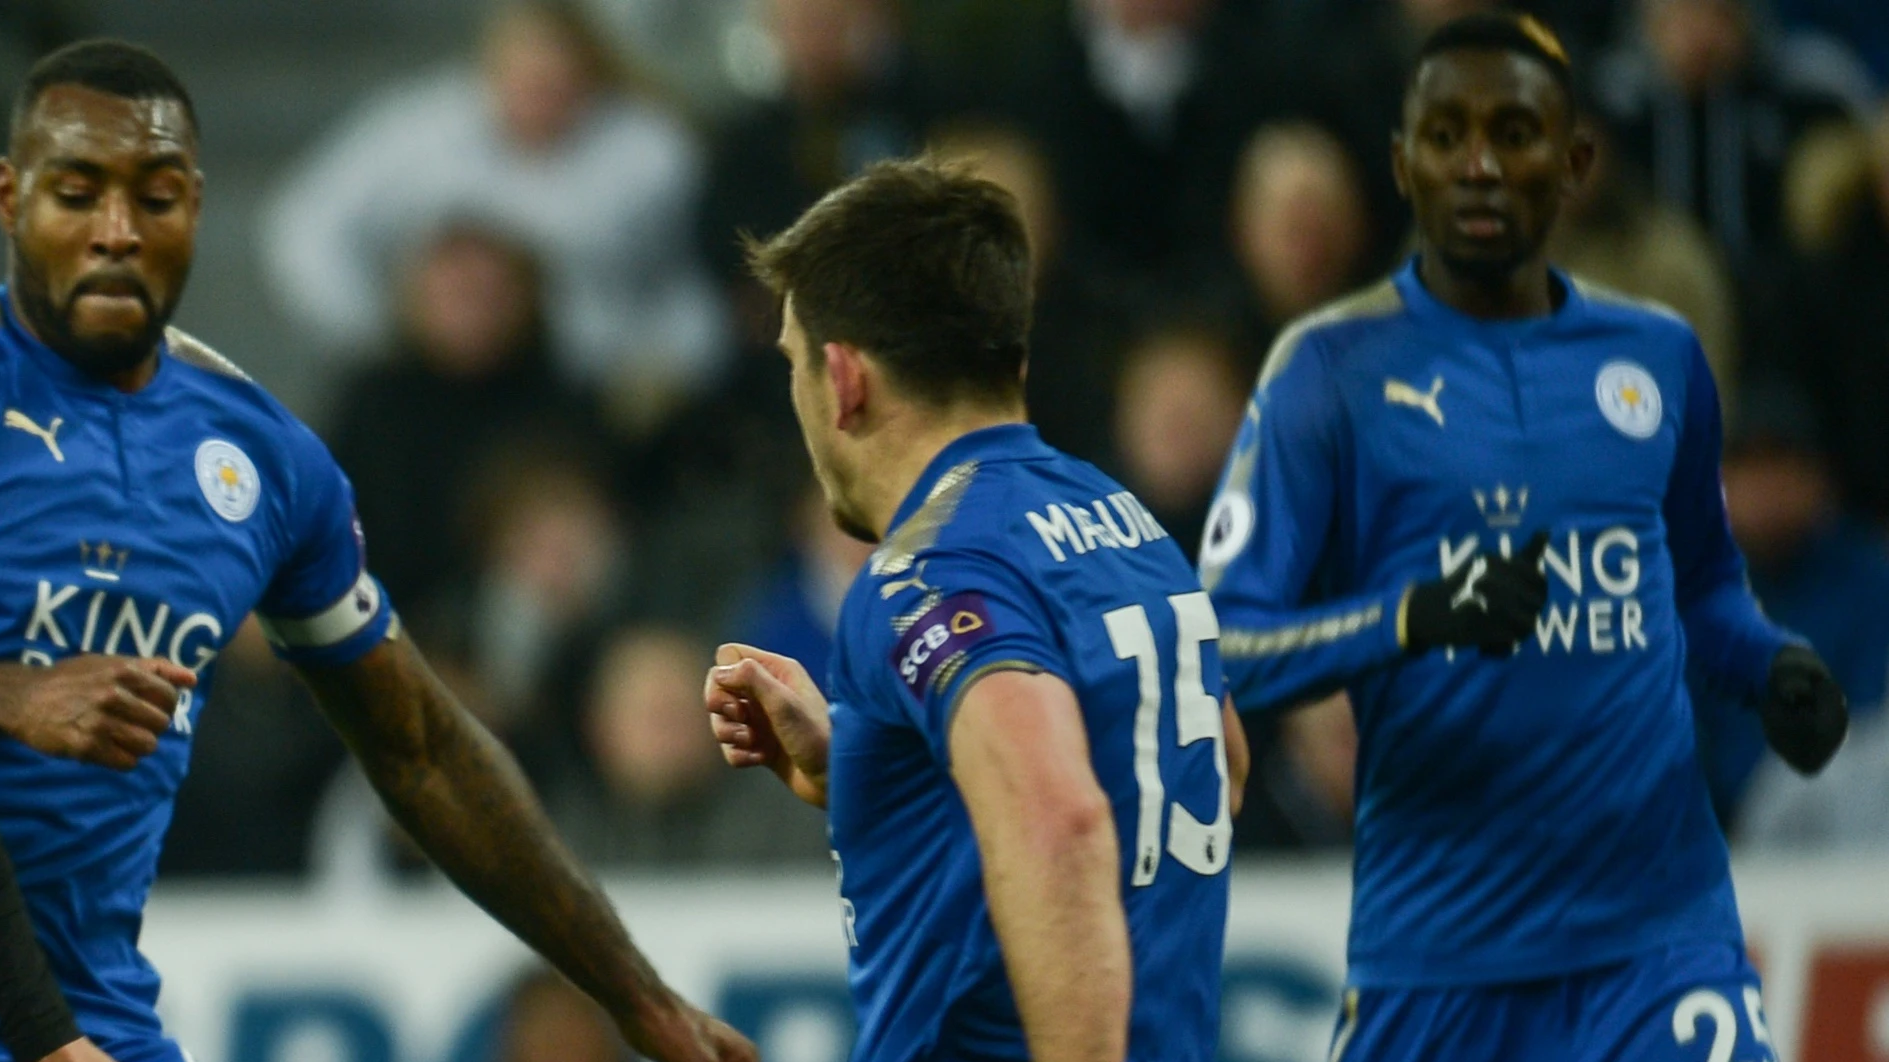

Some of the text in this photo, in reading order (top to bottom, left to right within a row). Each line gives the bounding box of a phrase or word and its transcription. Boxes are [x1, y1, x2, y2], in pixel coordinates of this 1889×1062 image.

[23, 578, 216, 673] KING
[899, 623, 951, 685] SCB
[1103, 591, 1233, 888] 15
